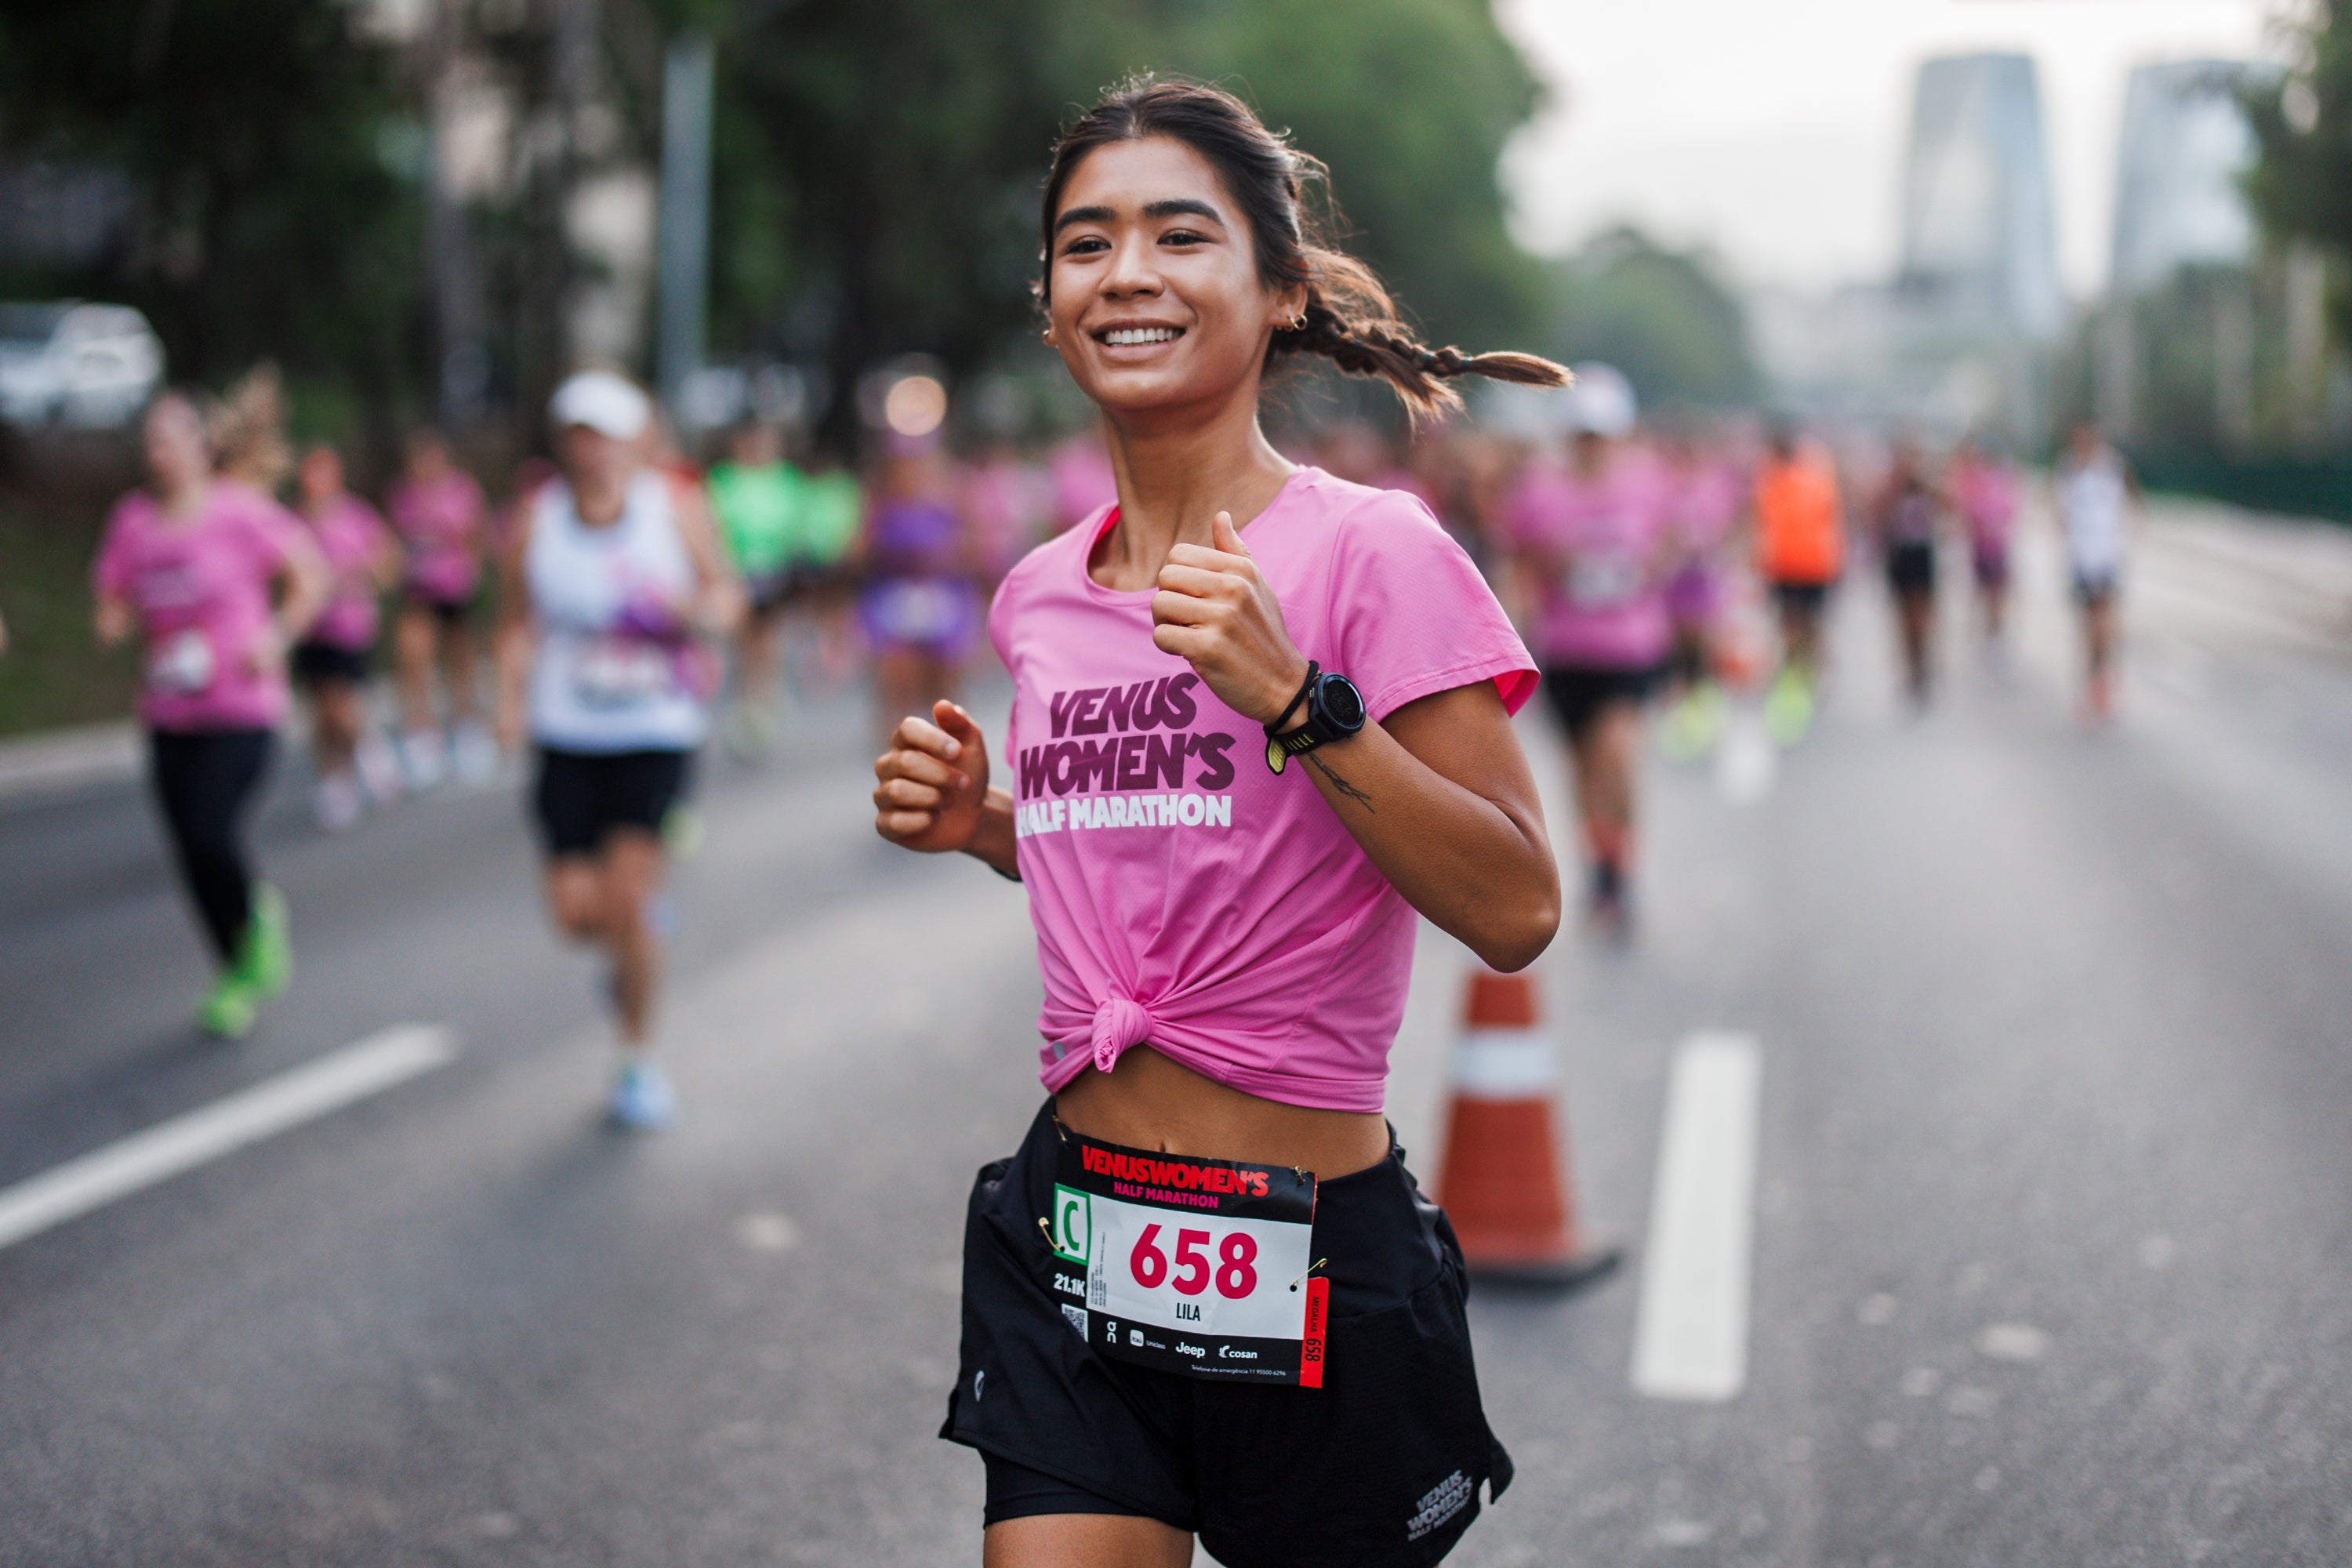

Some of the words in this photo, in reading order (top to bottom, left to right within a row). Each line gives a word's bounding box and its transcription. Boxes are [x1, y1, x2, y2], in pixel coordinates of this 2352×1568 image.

[1051, 672, 1200, 739] VENUS
[1021, 732, 1236, 800] WOMEN'S
[1016, 799, 1066, 839] HALF
[1069, 794, 1232, 829] MARATHON
[1114, 1181, 1144, 1197] HALF
[1145, 1187, 1218, 1208] MARATHON
[1064, 1200, 1080, 1251] C
[1130, 1223, 1258, 1299] 658
[1054, 1273, 1086, 1298] 21.1K
[1176, 1303, 1201, 1322] LILA
[1311, 1297, 1319, 1332] MEDALHA
[1176, 1341, 1206, 1358] Jeep
[1229, 1350, 1258, 1359] cosan
[1305, 1338, 1321, 1362] 658
[1406, 1476, 1472, 1530] WOMEN'S
[1417, 1469, 1463, 1512] VENUS
